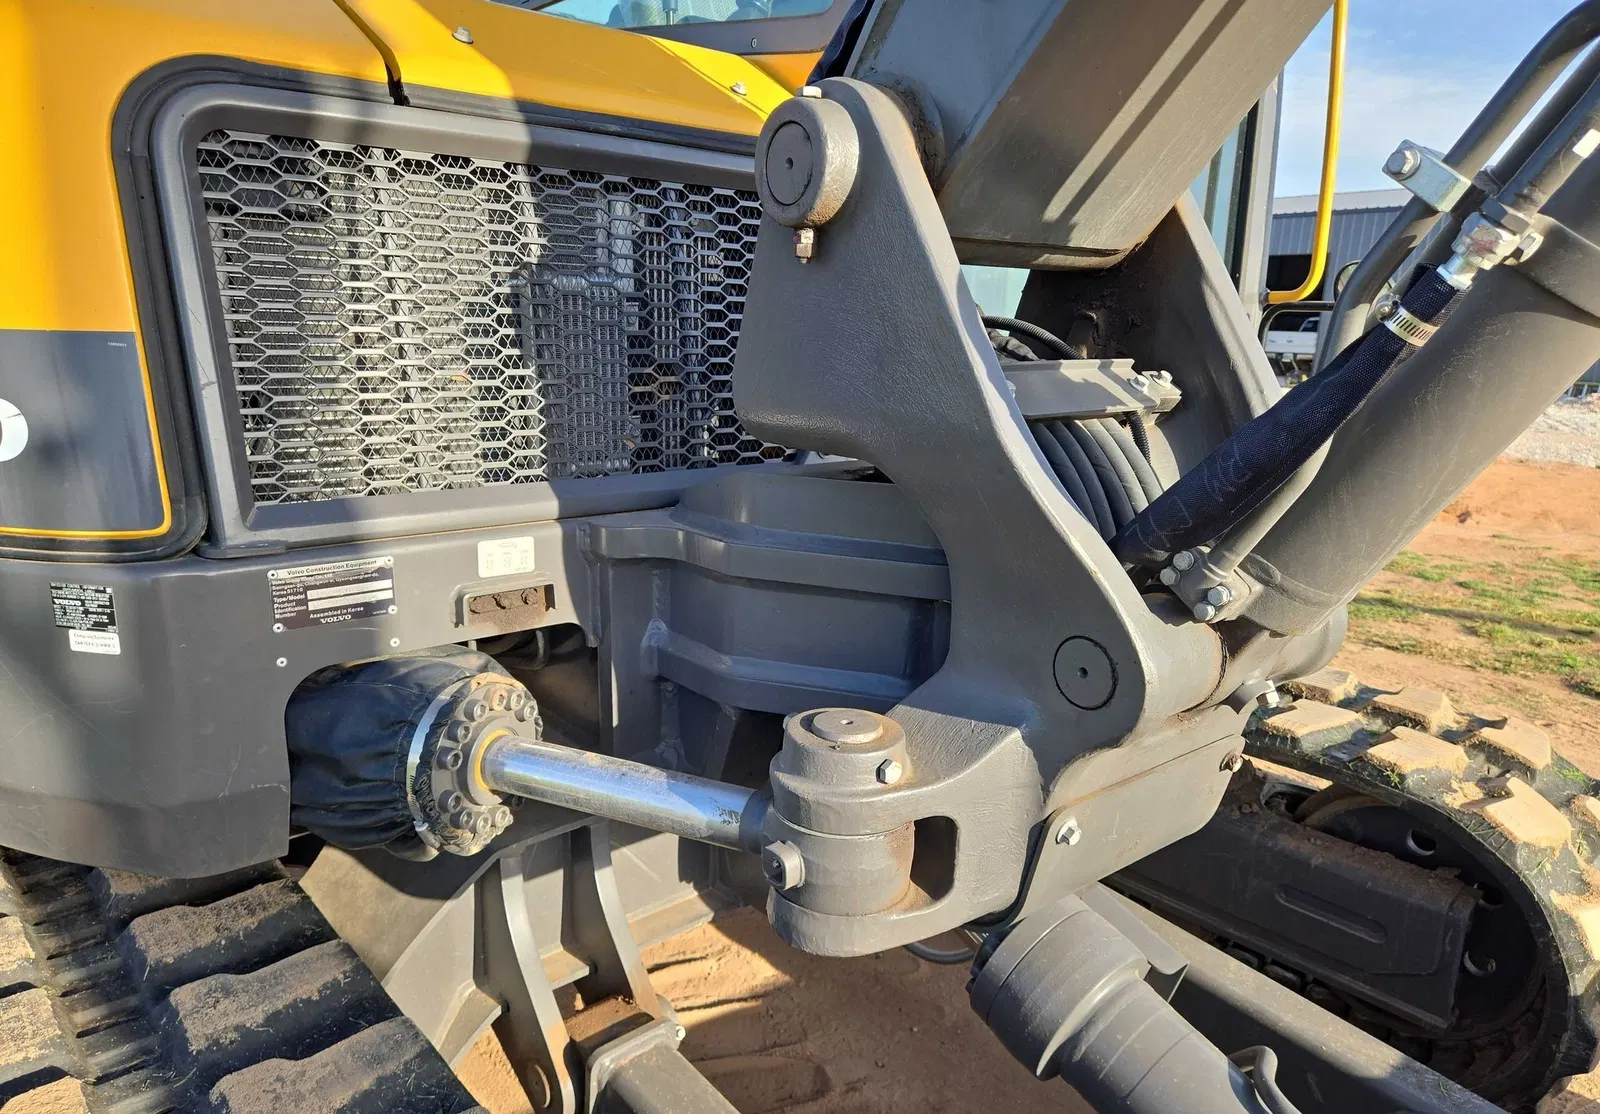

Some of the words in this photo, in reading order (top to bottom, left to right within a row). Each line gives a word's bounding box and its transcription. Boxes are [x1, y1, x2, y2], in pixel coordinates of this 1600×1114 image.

[306, 564, 345, 573] Construction
[346, 560, 377, 569] Equipment
[273, 593, 305, 603] Type/Model
[275, 605, 307, 614] Identification
[309, 610, 340, 619] Assembled
[320, 614, 352, 624] VOLVO
